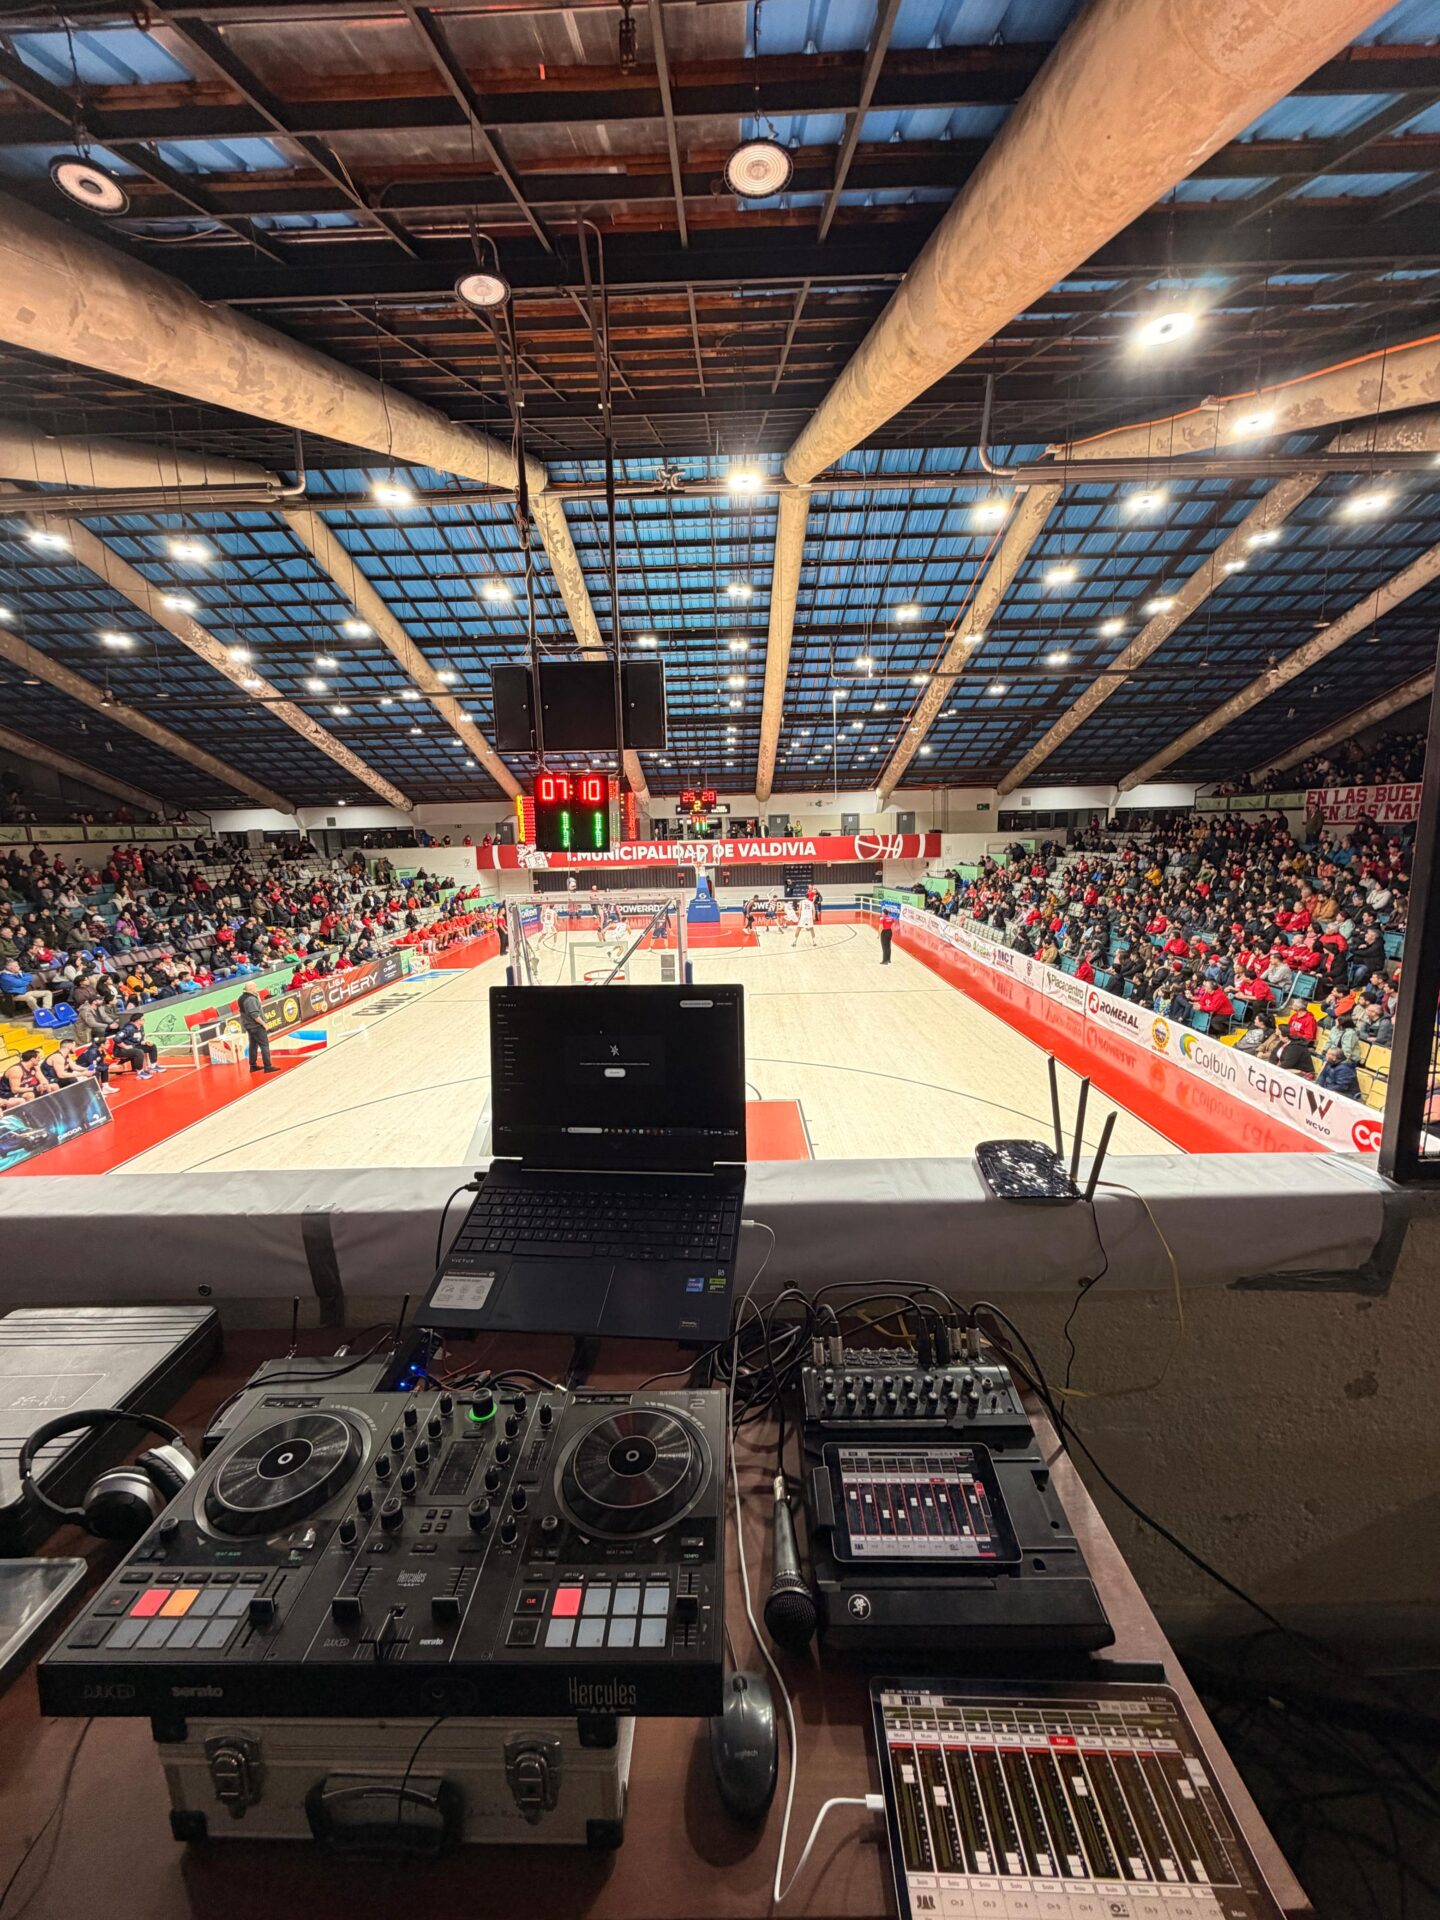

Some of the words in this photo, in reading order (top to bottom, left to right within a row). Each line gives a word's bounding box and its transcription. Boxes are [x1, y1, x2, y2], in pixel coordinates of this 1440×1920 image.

[541, 779, 600, 800] 07:10
[1306, 790, 1328, 805] EN
[1333, 788, 1368, 804] LAS
[1345, 804, 1378, 820] LAS
[712, 842, 734, 858] DE
[738, 841, 816, 857] VALDIVIA
[328, 977, 345, 989] LIGA
[329, 972, 378, 1003] CHERY
[1100, 1002, 1139, 1029] ROMERAL
[1247, 1065, 1303, 1110] tapel
[689, 1398, 705, 1409] 2
[171, 1684, 223, 1698] serato
[568, 1676, 636, 1704] Hercules
